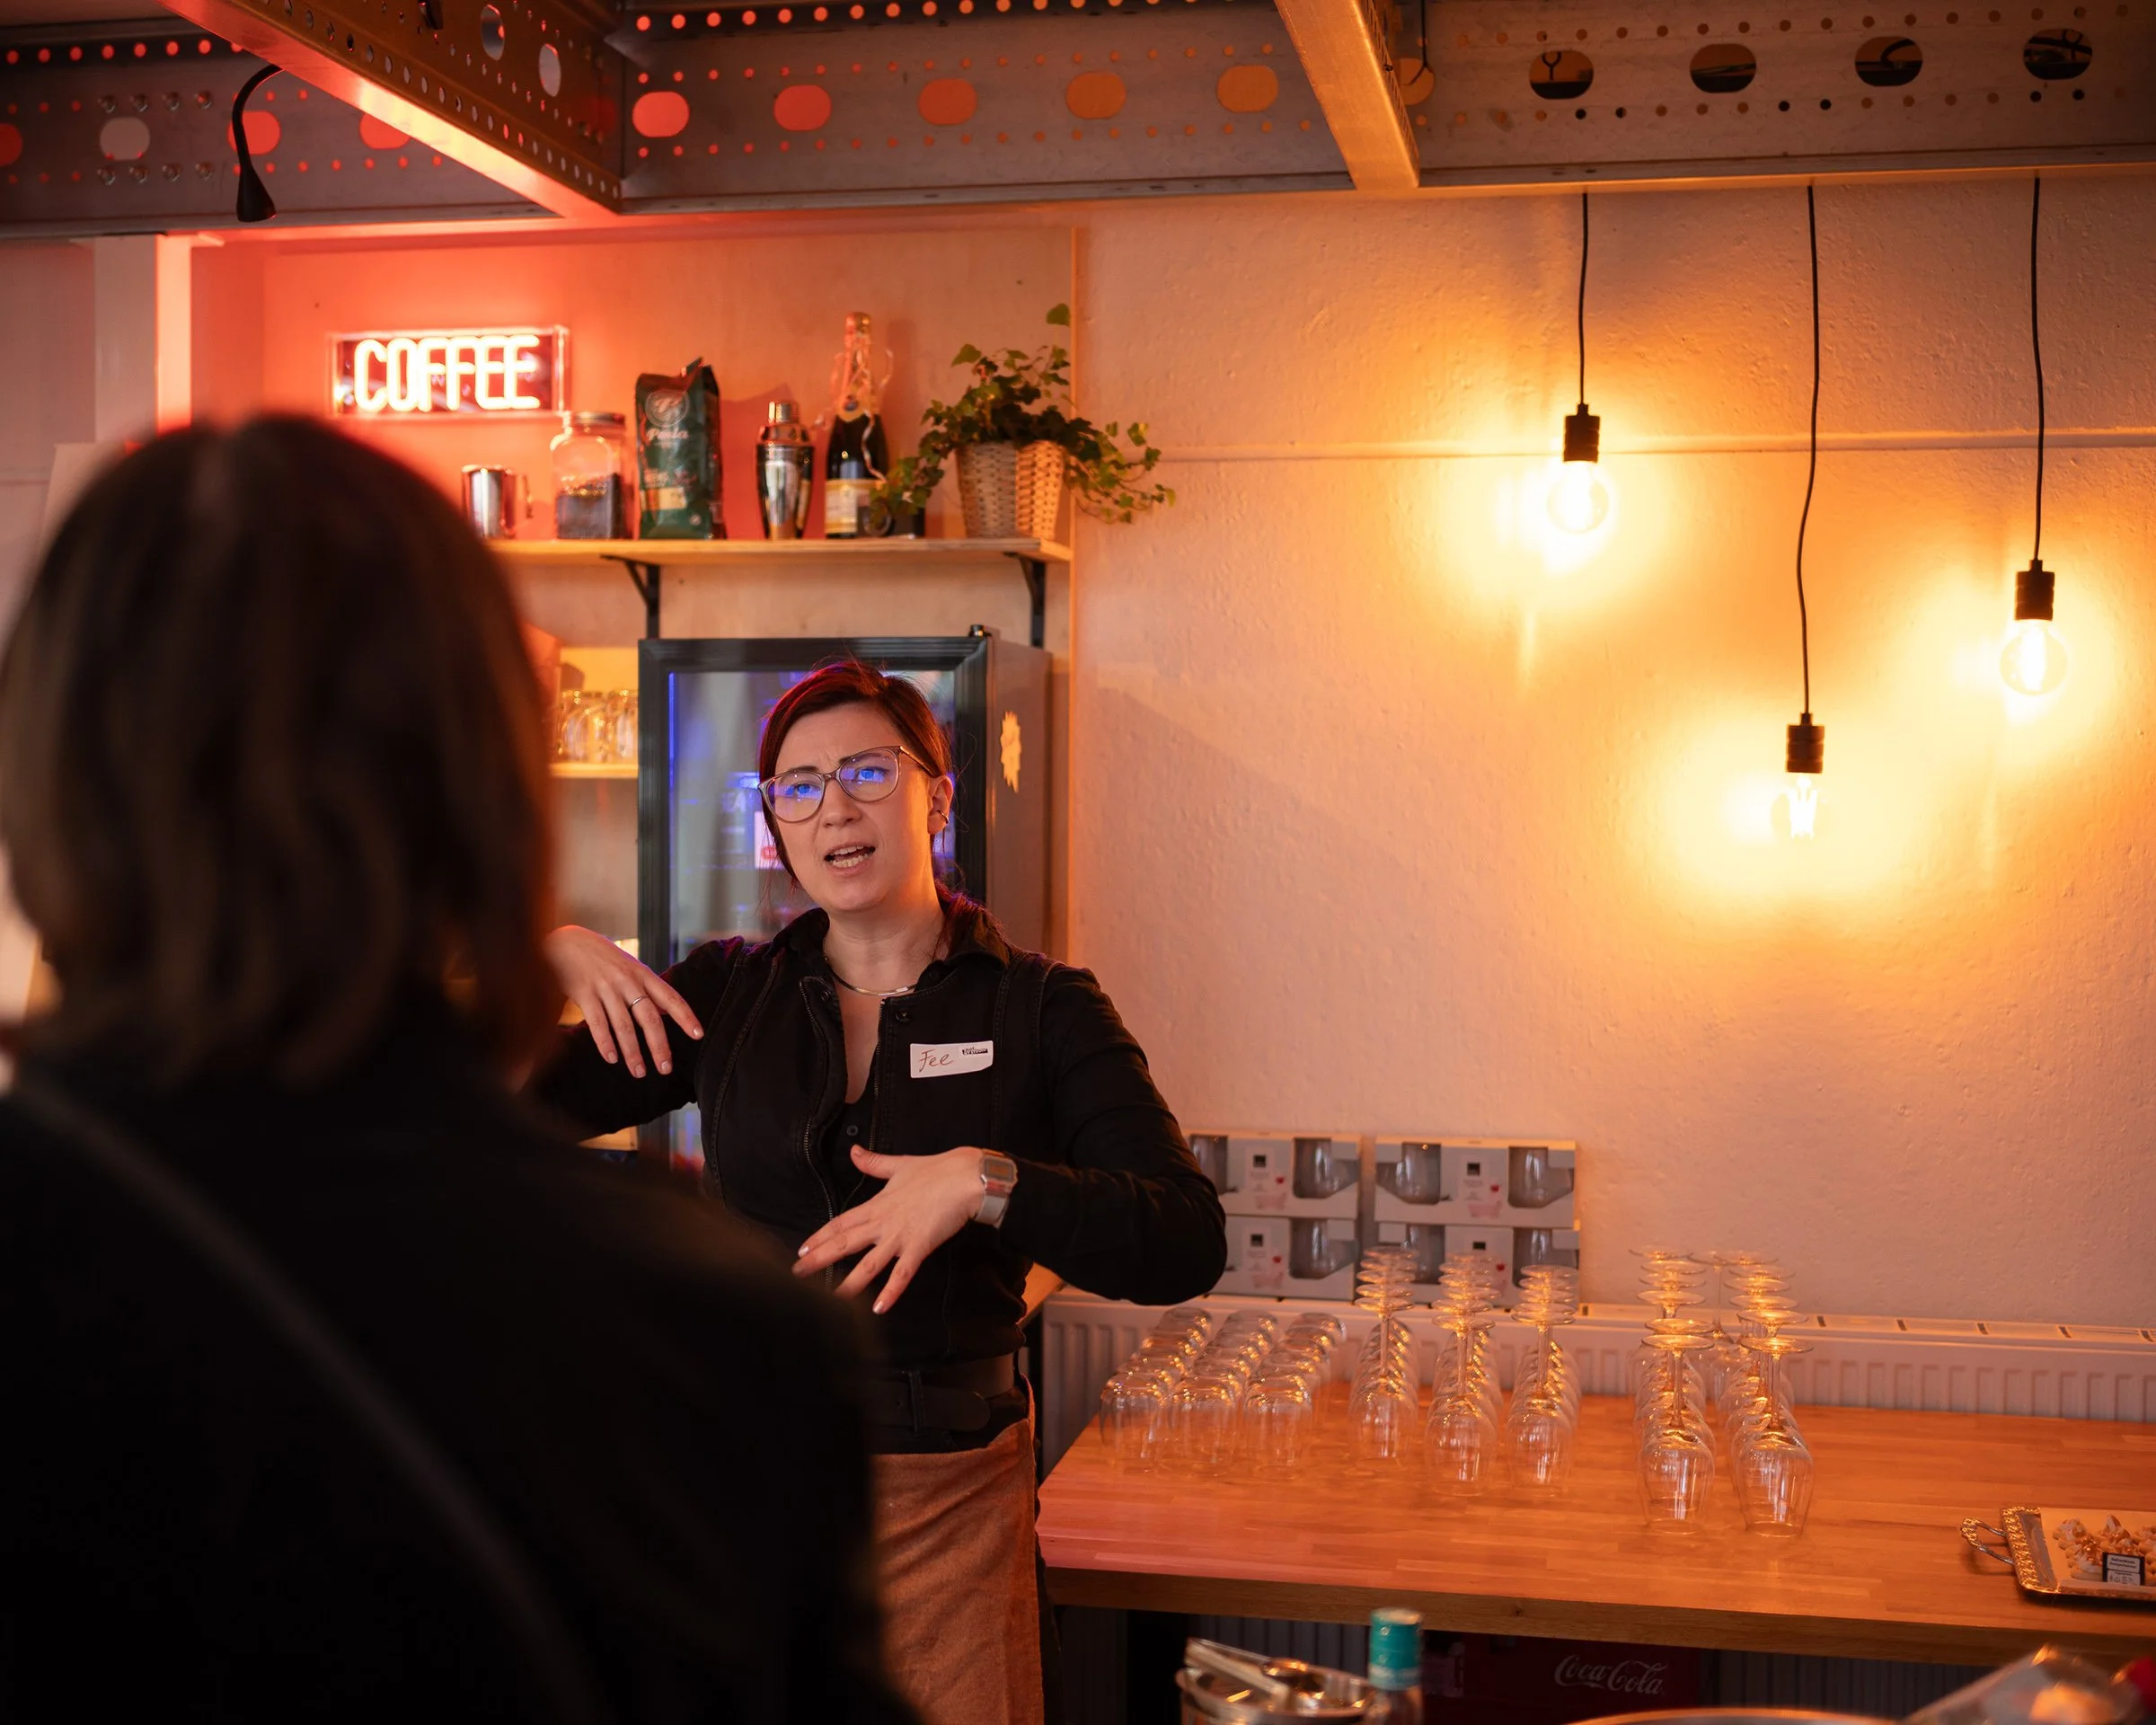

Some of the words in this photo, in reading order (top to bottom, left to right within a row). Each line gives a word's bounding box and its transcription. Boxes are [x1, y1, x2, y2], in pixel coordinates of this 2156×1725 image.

[353, 334, 541, 412] COFFEE
[918, 1048, 954, 1073] Fee
[1554, 1654, 1669, 1696] Coca-Cola
